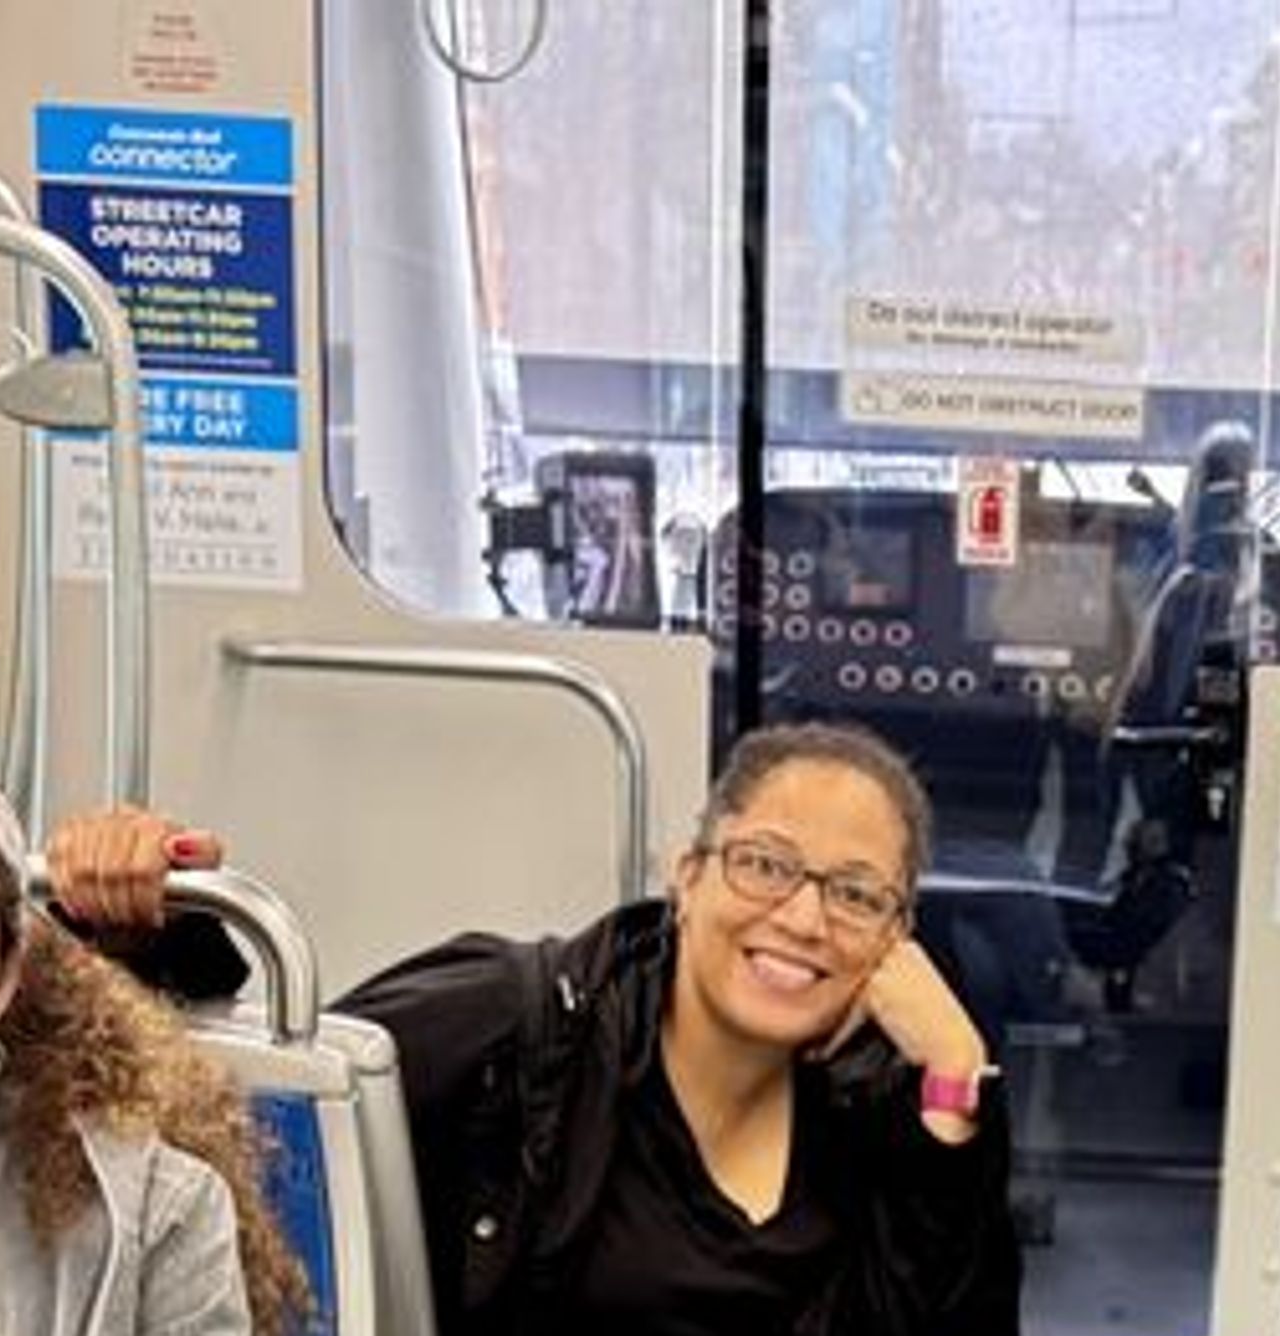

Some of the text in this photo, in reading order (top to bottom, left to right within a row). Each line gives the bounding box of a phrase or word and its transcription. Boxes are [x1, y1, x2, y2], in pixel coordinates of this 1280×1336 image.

[89, 144, 238, 175] connector
[91, 196, 243, 229] STREETCAR
[91, 223, 243, 257] OPERATING
[123, 252, 213, 279] HOURS
[175, 387, 245, 415] FREE
[900, 388, 933, 411] DO
[936, 392, 974, 414] NOT
[193, 414, 248, 441] DAY
